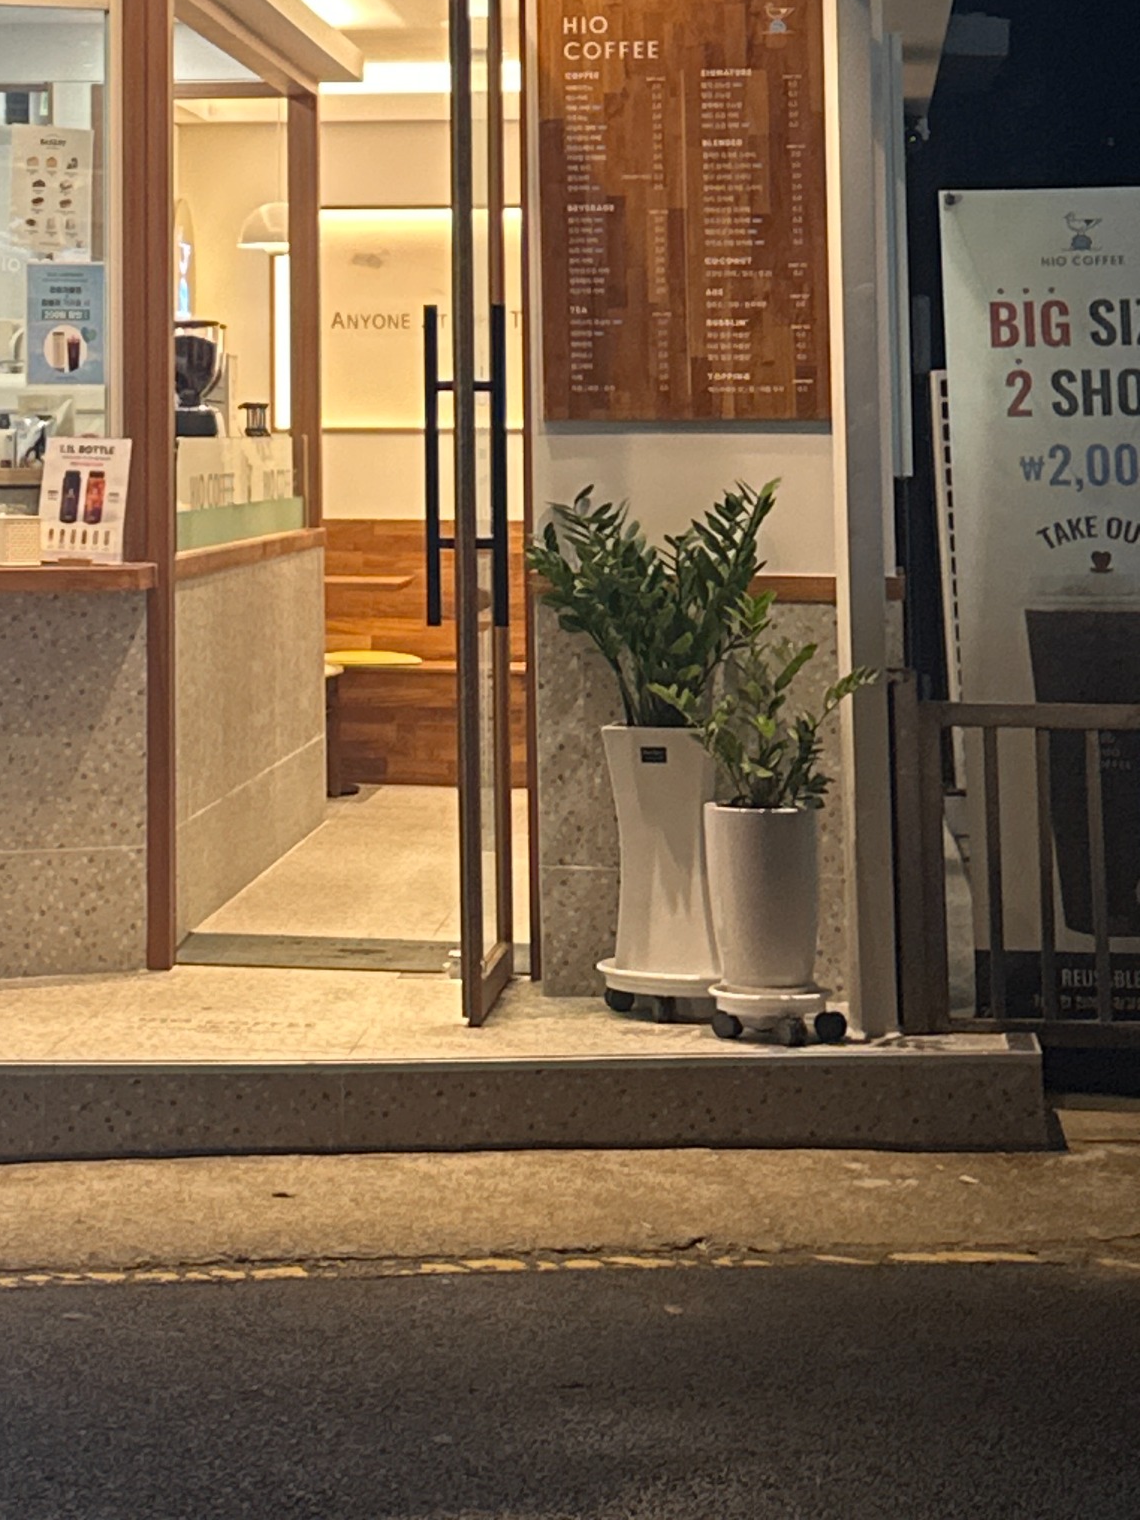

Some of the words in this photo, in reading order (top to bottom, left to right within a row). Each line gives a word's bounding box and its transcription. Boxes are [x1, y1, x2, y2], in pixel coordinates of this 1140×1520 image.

[563, 15, 609, 35] HIO
[563, 40, 660, 61] COFFEE
[1041, 255, 1067, 267] HIO
[1072, 255, 1125, 267] COFFEE
[330, 311, 411, 330] ANYONE
[989, 299, 1071, 348] BIG
[1089, 298, 1140, 347] SI
[1005, 369, 1033, 417] 2
[1035, 515, 1099, 550] TAKE
